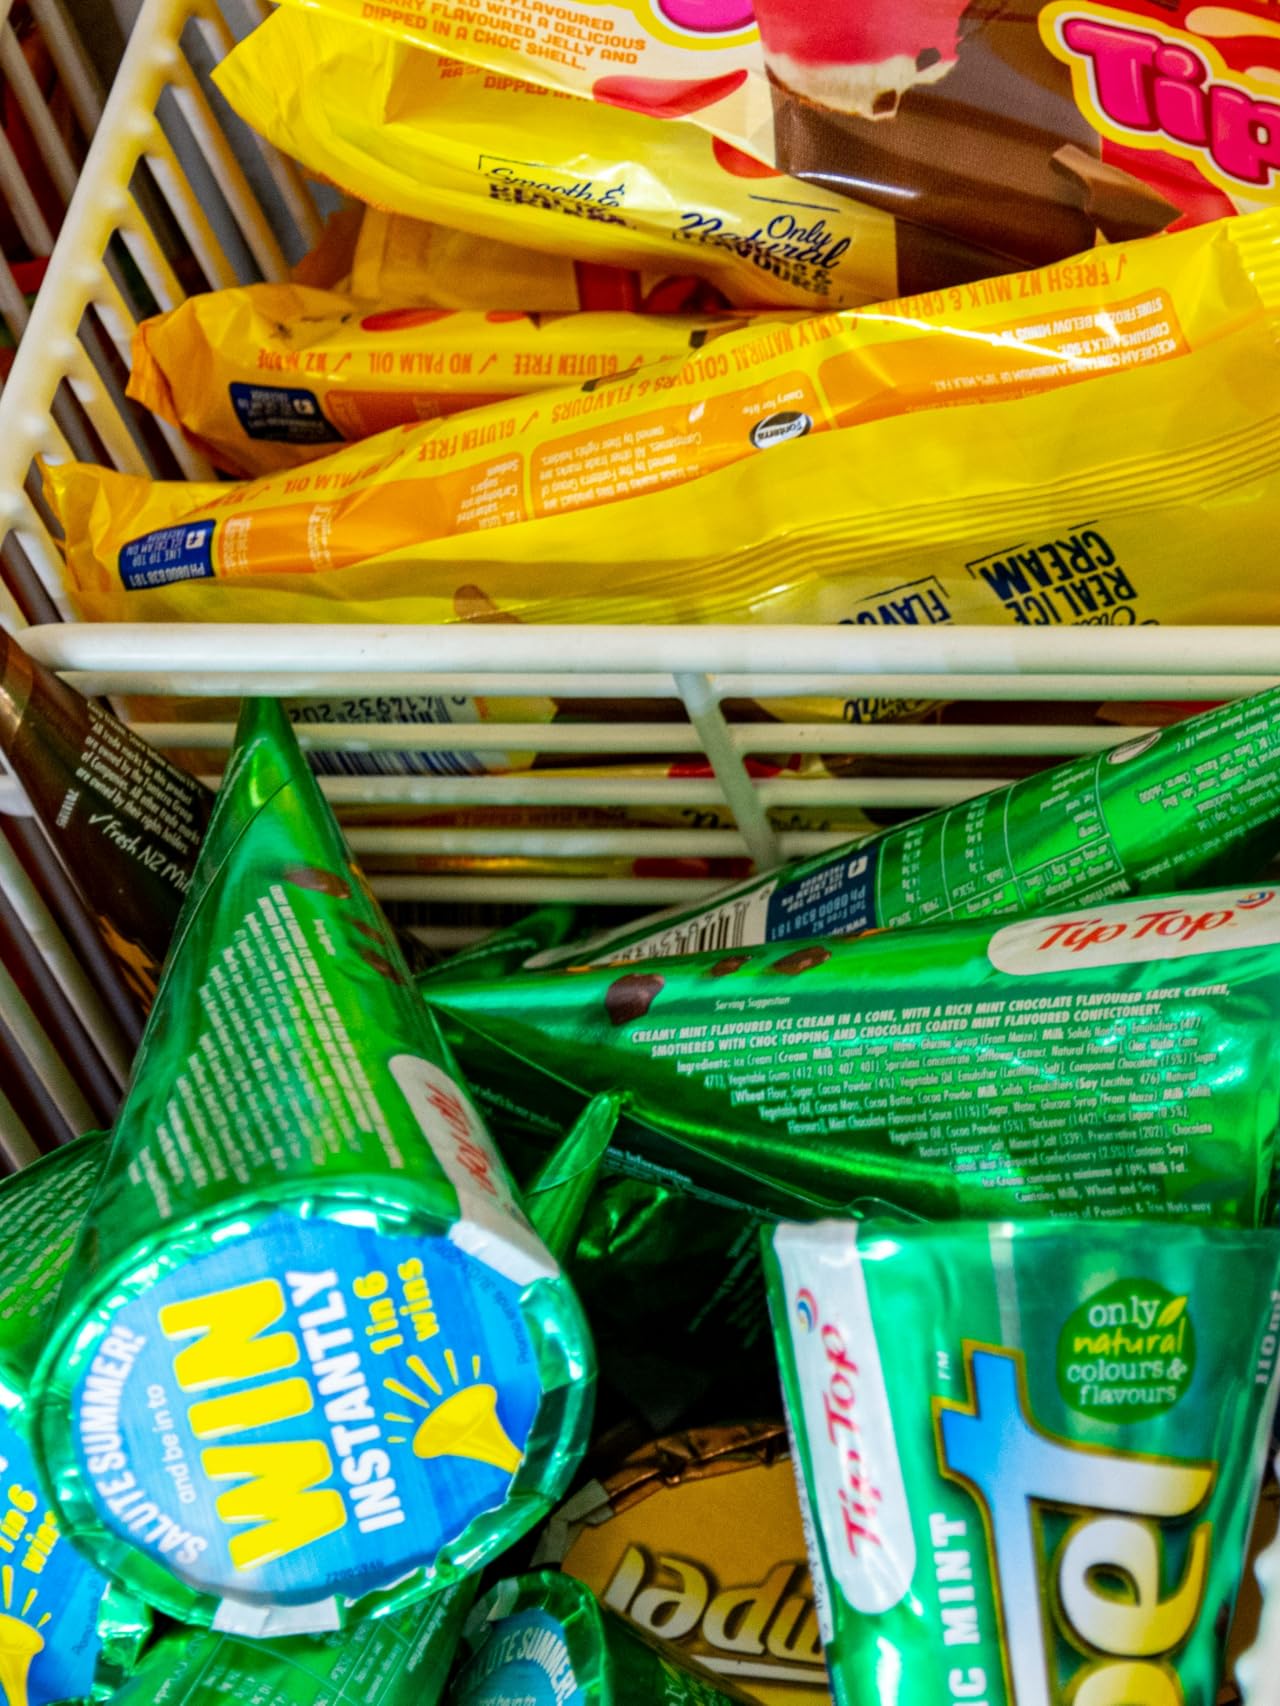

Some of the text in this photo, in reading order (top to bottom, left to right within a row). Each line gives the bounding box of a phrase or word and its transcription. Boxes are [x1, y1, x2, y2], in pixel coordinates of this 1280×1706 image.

[362, 3, 427, 30] DIPPED
[432, 21, 451, 36] IN
[455, 28, 467, 40] A
[473, 29, 521, 51] CHOC
[525, 42, 586, 71] SHELL.
[430, 3, 535, 38] FLAVOURED
[541, 33, 594, 57] JELLY
[601, 49, 638, 65] AND
[487, 1, 531, 22] WITH
[538, 16, 548, 28] A
[554, 20, 646, 51] DELICIOUS
[765, 209, 835, 250] Only
[969, 278, 1013, 305] MILK
[1016, 272, 1044, 296] NZ
[1049, 259, 1109, 290] FRESH
[368, 351, 393, 372] OIL
[397, 351, 444, 372] PALM
[447, 351, 472, 372] NO
[513, 351, 552, 372] FREE
[555, 351, 617, 372] GLUTEN
[727, 327, 797, 367] NATURAL
[547, 382, 638, 423] FLAVOURS
[414, 416, 520, 463] GLUTEN FREE
[978, 527, 1118, 579] CREAM
[1005, 588, 1062, 625] ICE
[1053, 565, 1138, 622] REAL
[99, 817, 197, 894] Fresh NZ Mil
[1034, 907, 1236, 954] Tip Top
[633, 983, 1230, 1043] CREAMY MINT FLAVOURED ICE CREAM IN A CONE, WITH A RICH MINT CHOCOLATE FLAVOURED SAUCE CENTRE,
[650, 1040, 715, 1057] SMOTHERED
[718, 1037, 746, 1051] WITH
[749, 1034, 778, 1048] CHOC
[780, 1030, 829, 1046] TOPPING
[832, 1027, 858, 1041] AND
[859, 1022, 922, 1039] CHOCOLATE
[925, 1018, 968, 1033] COATED
[970, 1016, 1002, 1029] MINT
[1004, 1010, 1070, 1027] FLAVOURED
[676, 1056, 731, 1076] Ingredients:
[353, 1271, 388, 1300] 6
[399, 1258, 440, 1341] wins
[364, 1300, 398, 1335] in
[1089, 1295, 1159, 1331] only
[1072, 1314, 1185, 1358] natural
[1066, 1358, 1188, 1383] colours &
[286, 1269, 406, 1534] INSTANTLY
[1079, 1381, 1179, 1406] flavours
[81, 1325, 208, 1564] SALUTE SUMMER!
[141, 1381, 198, 1506] and be in to
[159, 1277, 348, 1572] WIN
[821, 1322, 885, 1559] Tip Top
[0, 1483, 38, 1543] in 6
[928, 1512, 979, 1648] MINT
